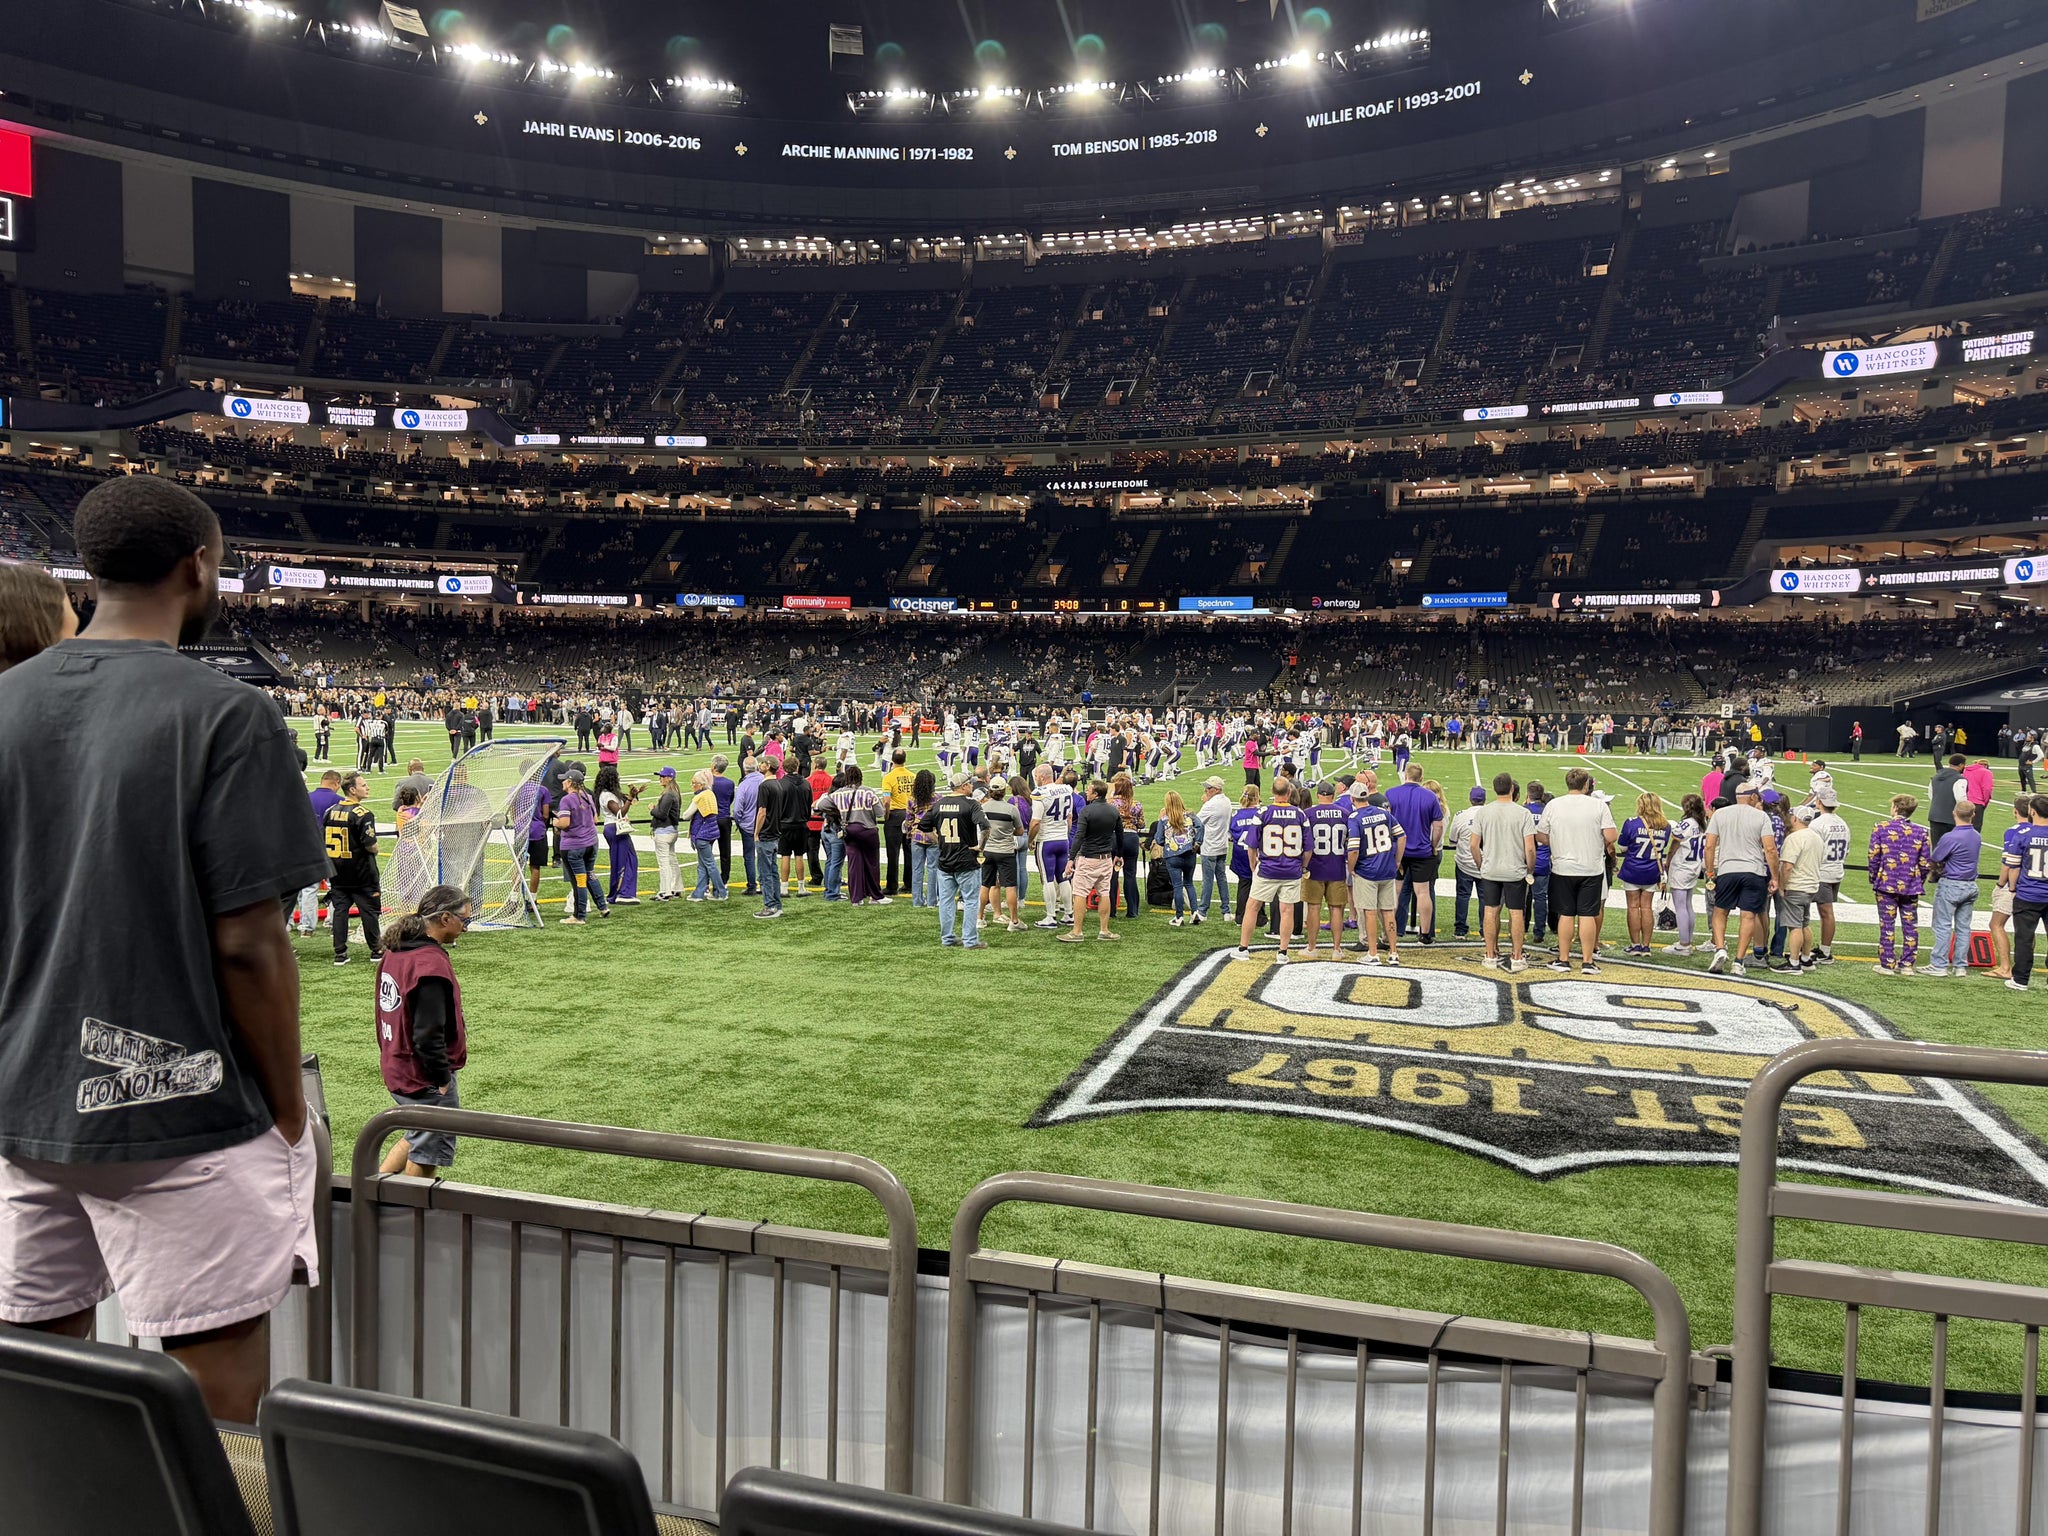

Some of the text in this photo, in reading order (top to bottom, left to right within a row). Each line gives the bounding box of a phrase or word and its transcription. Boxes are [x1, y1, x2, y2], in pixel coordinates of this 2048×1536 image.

[1306, 81, 1481, 128] WILLIE ROAF 1993-2001
[523, 120, 701, 150] JAHRI EVANS 2006-2016
[1052, 130, 1217, 156] TOM BENSON 1985-2018
[782, 144, 973, 160] ARCHIE MANNING 1971-1982
[1962, 331, 2034, 350] PATRON SAINTS
[1866, 347, 1926, 362] HANCOCK
[1964, 341, 2031, 362] PARTNERS
[1866, 357, 1926, 371] WHITNEY
[256, 403, 302, 413] HANCOCK
[1552, 398, 1639, 413] PATRON SAINTS PARTNERS
[256, 410, 302, 419] WHITNEY
[354, 408, 376, 417] SAINTS
[330, 414, 374, 426] PARTNERS
[424, 420, 462, 428] WHITNEY
[1046, 480, 1148, 490] CAESARS SUPERDOME
[52, 568, 85, 580] PATRON
[284, 571, 318, 579] HANCOCK
[1803, 573, 1851, 582] HANCOCK
[1880, 568, 1999, 585] PATRON SAINTS PARTNERS
[284, 577, 318, 585] WHITNEY
[340, 576, 434, 589] PATRON SAINTS PARTNERS
[1803, 581, 1850, 589] WHITNEY
[541, 594, 627, 605] PATRON SAINTS PARTNERS
[900, 598, 954, 611] Ochsner
[1011, 600, 1017, 609] 0
[1121, 600, 1127, 610] 0
[1197, 599, 1232, 609] Spectrum
[1323, 598, 1361, 609] entergy
[1434, 595, 1507, 604] HANCOCK WHITNEY
[1585, 593, 1701, 606] PATRON SAINTS PARTNERS
[1724, 706, 1730, 716] 2
[898, 785, 914, 794] SAFET
[940, 804, 960, 812] KAMARA
[1046, 795, 1072, 821] 42
[1272, 810, 1296, 818] ALLEN
[1316, 810, 1342, 818] CARTER
[1362, 814, 1386, 825] JEFFERSON
[940, 818, 960, 844] 41
[326, 826, 352, 858] 51
[1262, 824, 1303, 857] 69
[1312, 824, 1347, 856] 80
[1364, 824, 1392, 856] 18
[2030, 837, 2048, 846] JEFFE
[1636, 837, 1666, 860] 72
[1827, 840, 1846, 861] 33
[382, 981, 392, 998] OX
[90, 1025, 165, 1065] POLITICS
[81, 1068, 172, 1106] HONOR
[1227, 1053, 1542, 1117] 1967
